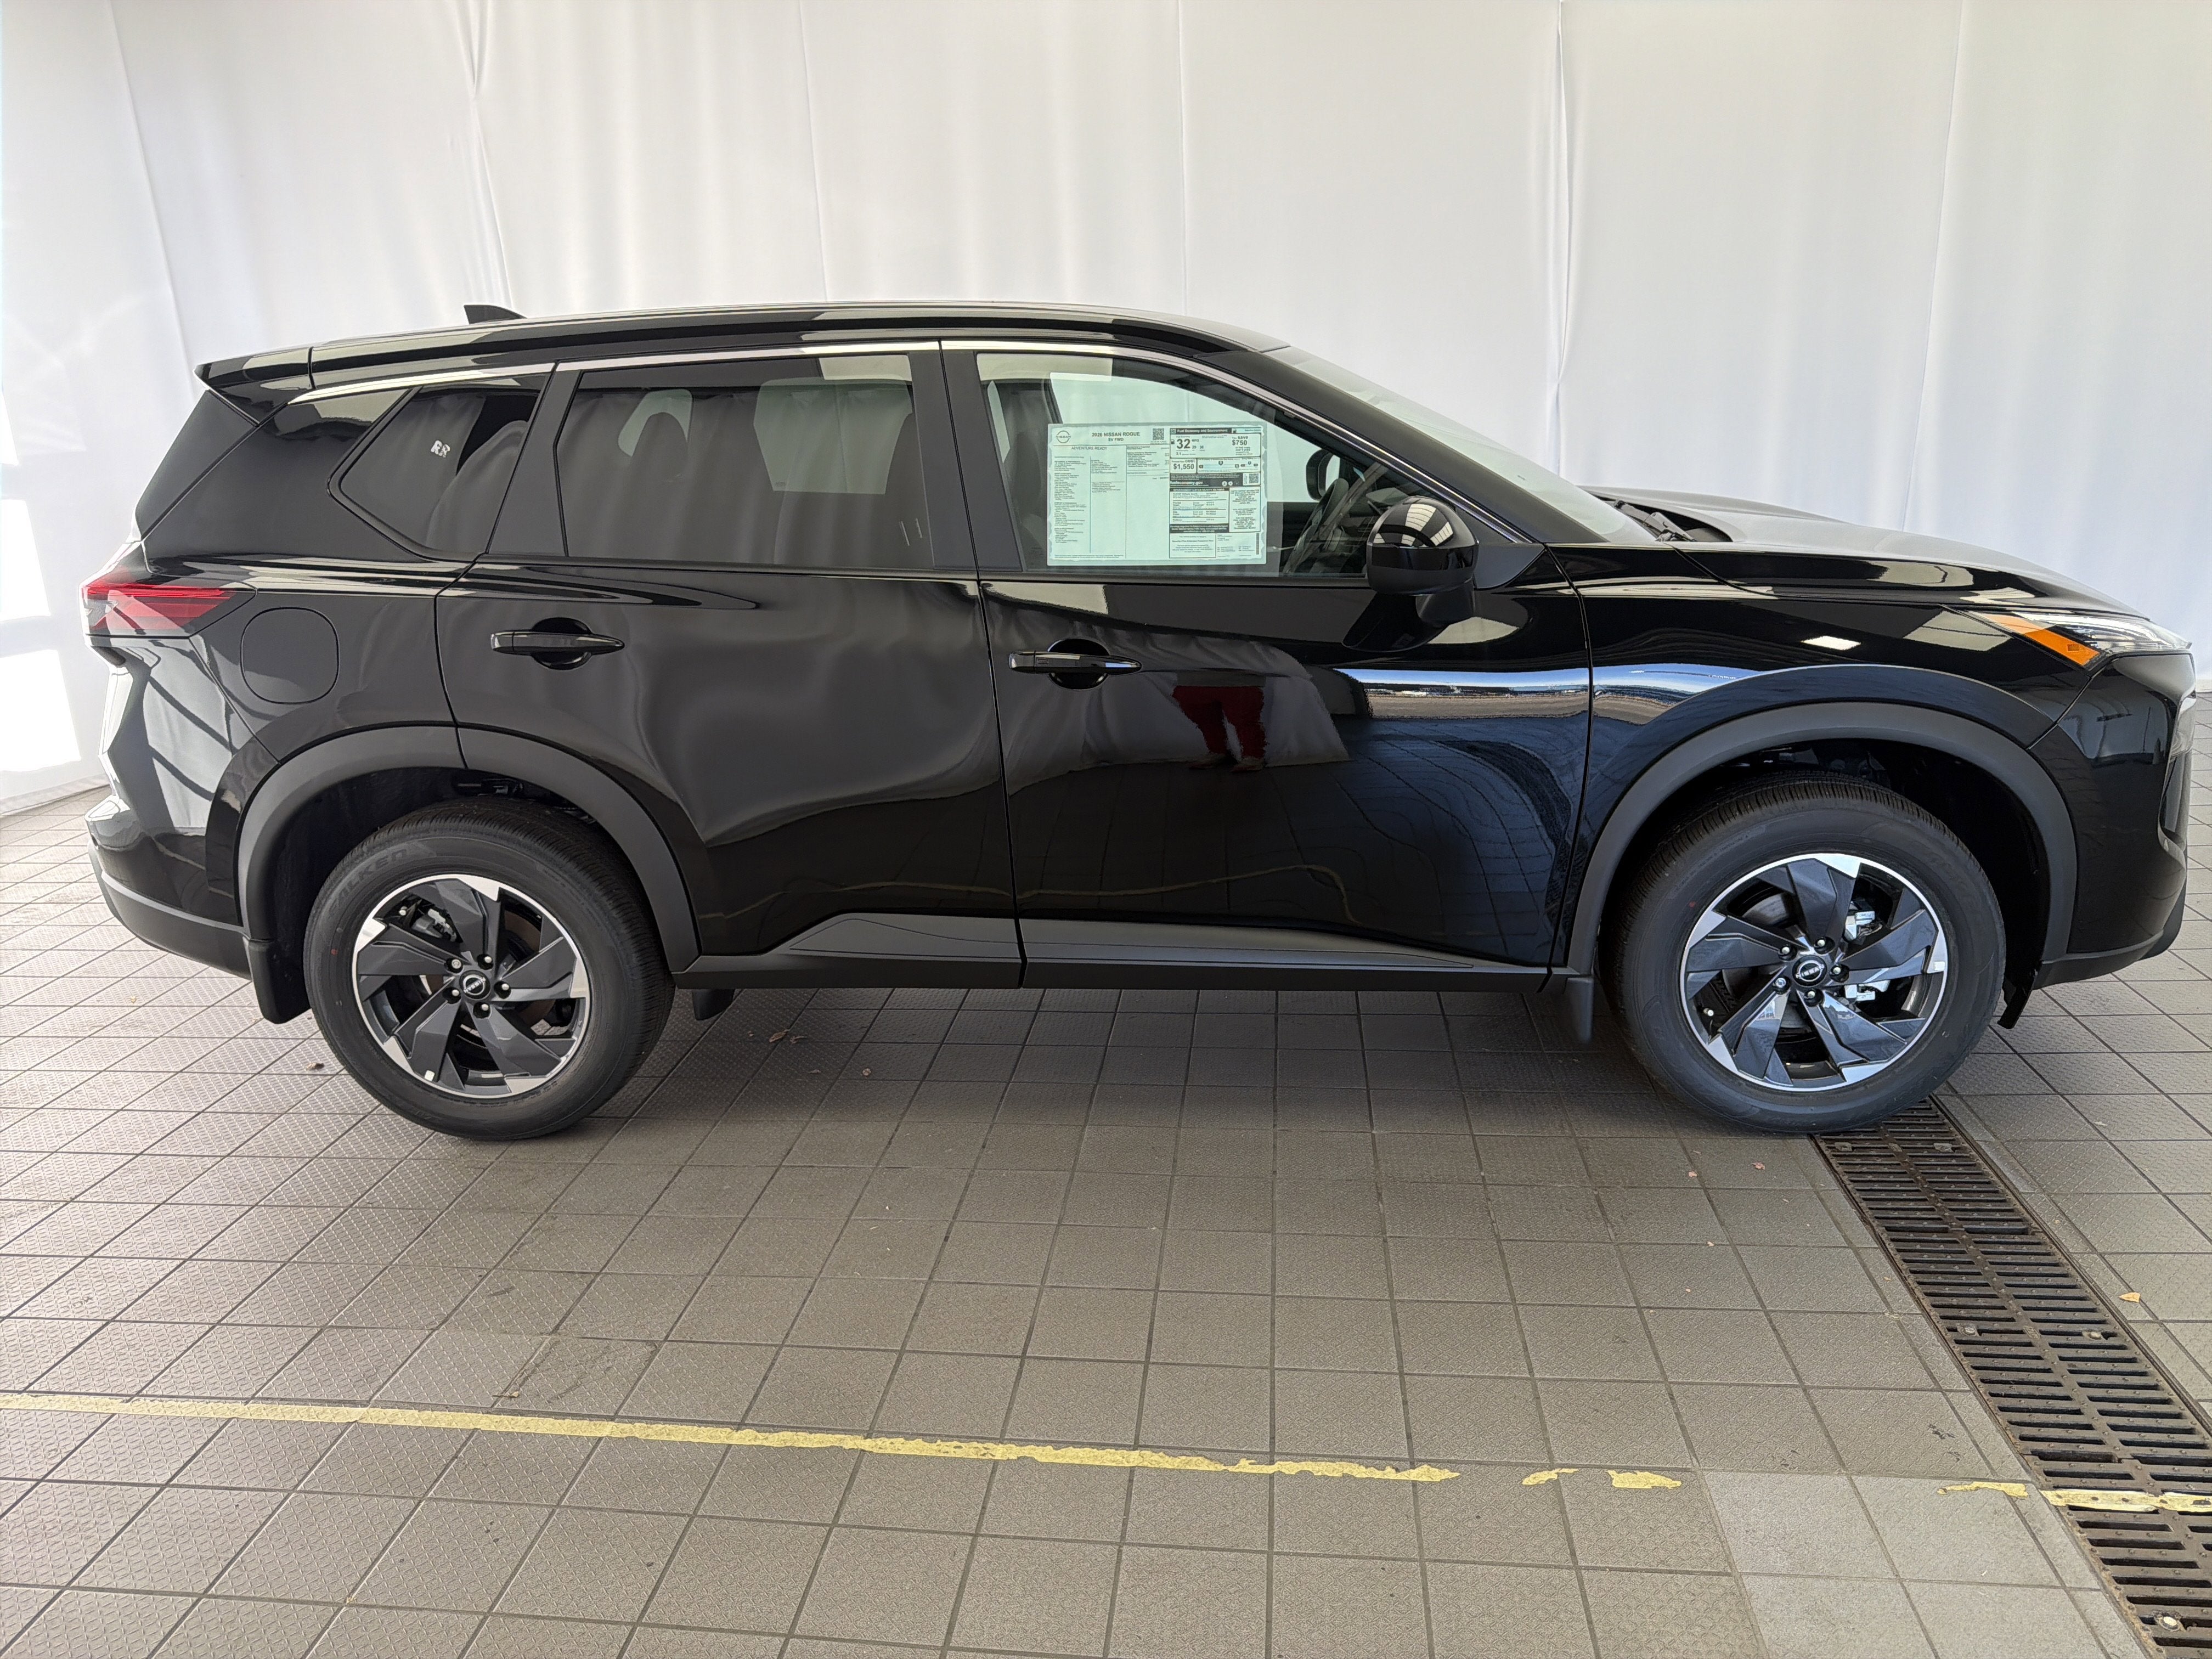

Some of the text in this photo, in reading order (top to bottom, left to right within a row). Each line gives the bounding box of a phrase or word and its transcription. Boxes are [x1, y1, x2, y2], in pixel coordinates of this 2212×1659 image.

[1176, 438, 1190, 449] 32
[1795, 964, 1825, 979] NISSAN
[463, 977, 486, 994] NISSAN
